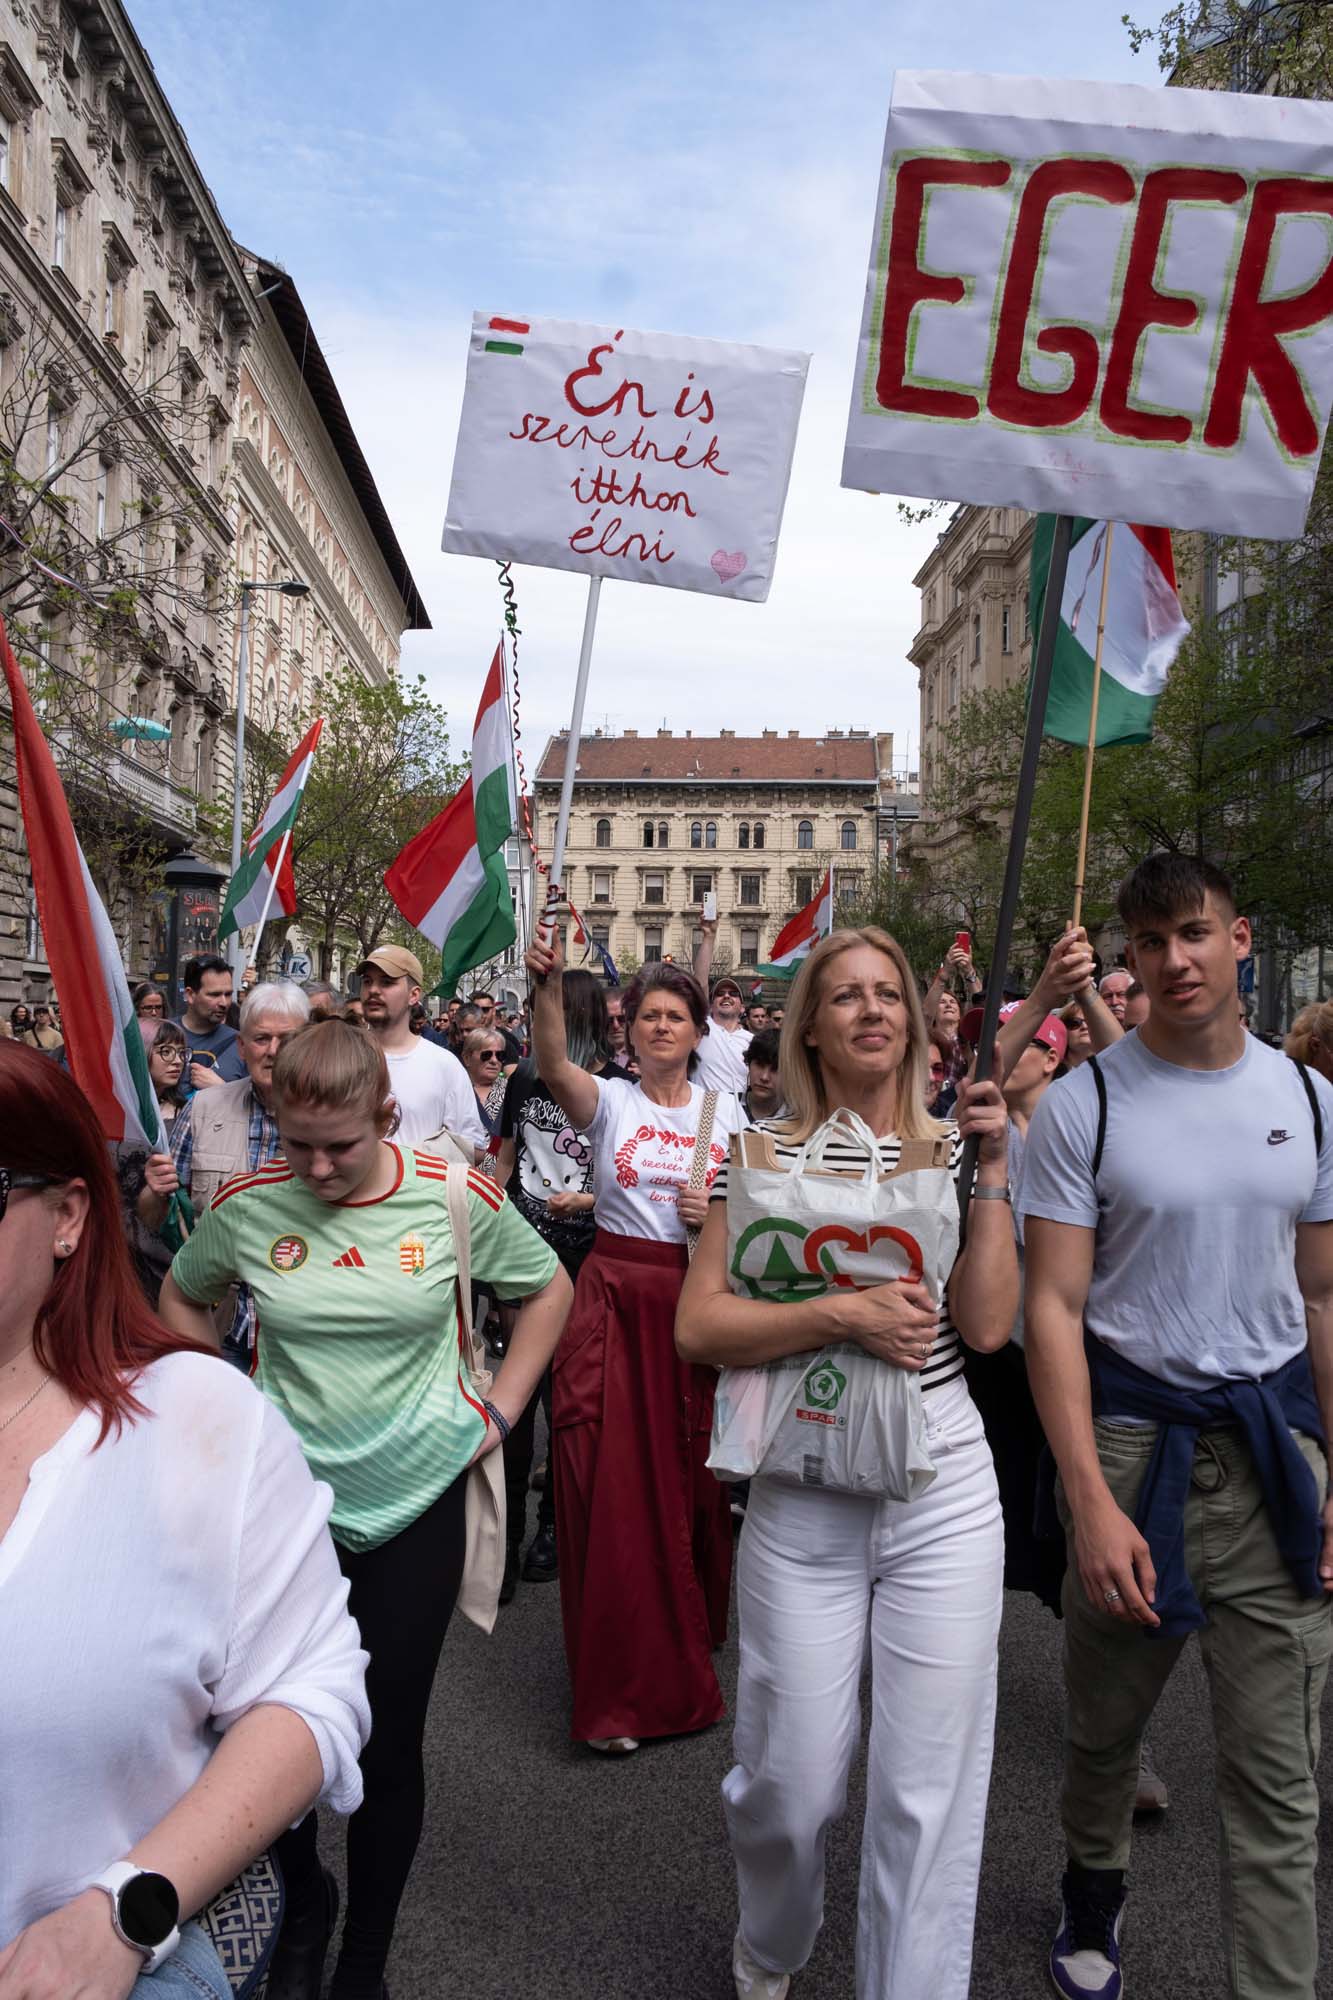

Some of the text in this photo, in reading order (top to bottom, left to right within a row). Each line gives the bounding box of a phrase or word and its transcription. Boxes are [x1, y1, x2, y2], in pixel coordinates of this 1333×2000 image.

[873, 155, 1333, 460] EGER
[564, 329, 714, 424] Én is
[509, 413, 730, 476] szeretnék
[570, 464, 697, 518] itthon
[568, 508, 675, 564] élni
[800, 1411, 835, 1425] SPAR
